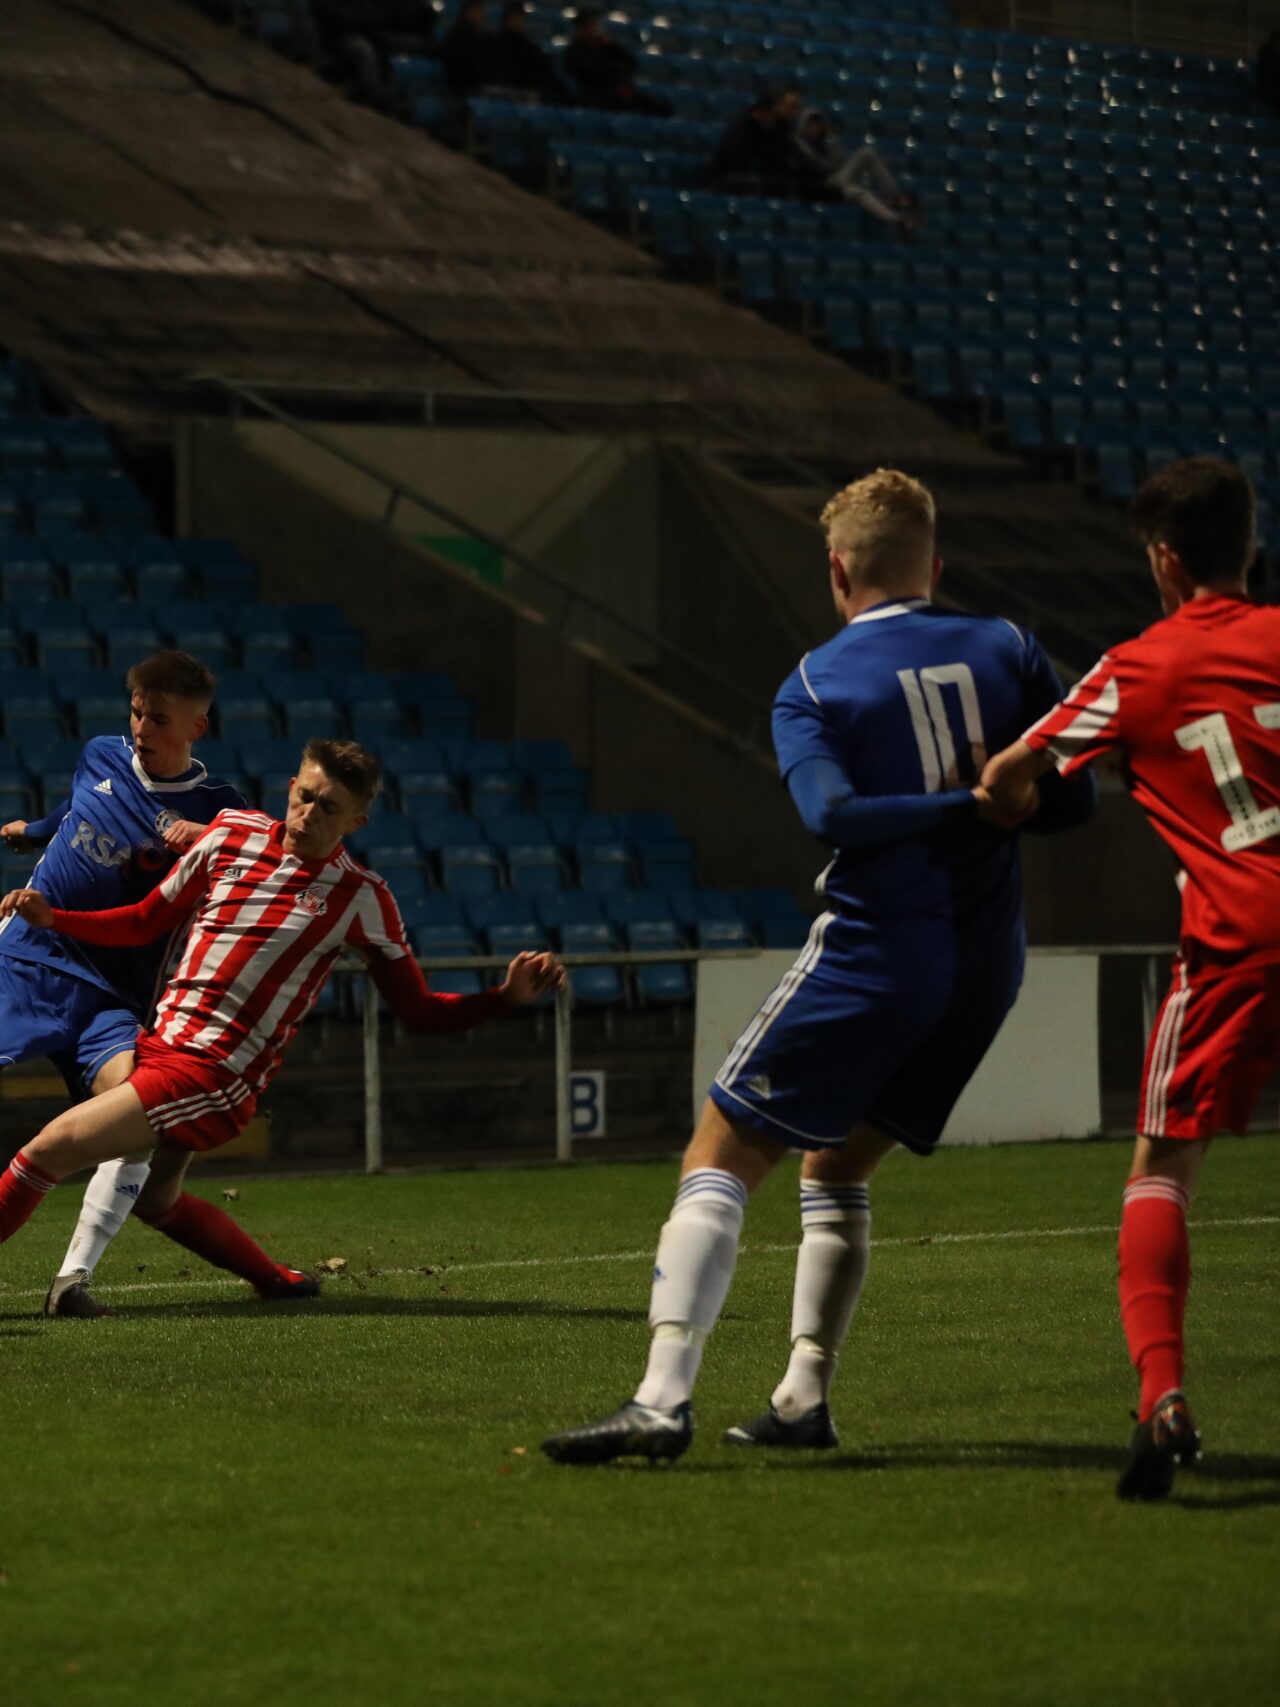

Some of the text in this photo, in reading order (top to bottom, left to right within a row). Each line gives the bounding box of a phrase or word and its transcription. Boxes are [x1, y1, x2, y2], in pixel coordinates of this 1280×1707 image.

[896, 662, 987, 795] 10
[1173, 702, 1280, 853] 1
[570, 1077, 599, 1133] B
